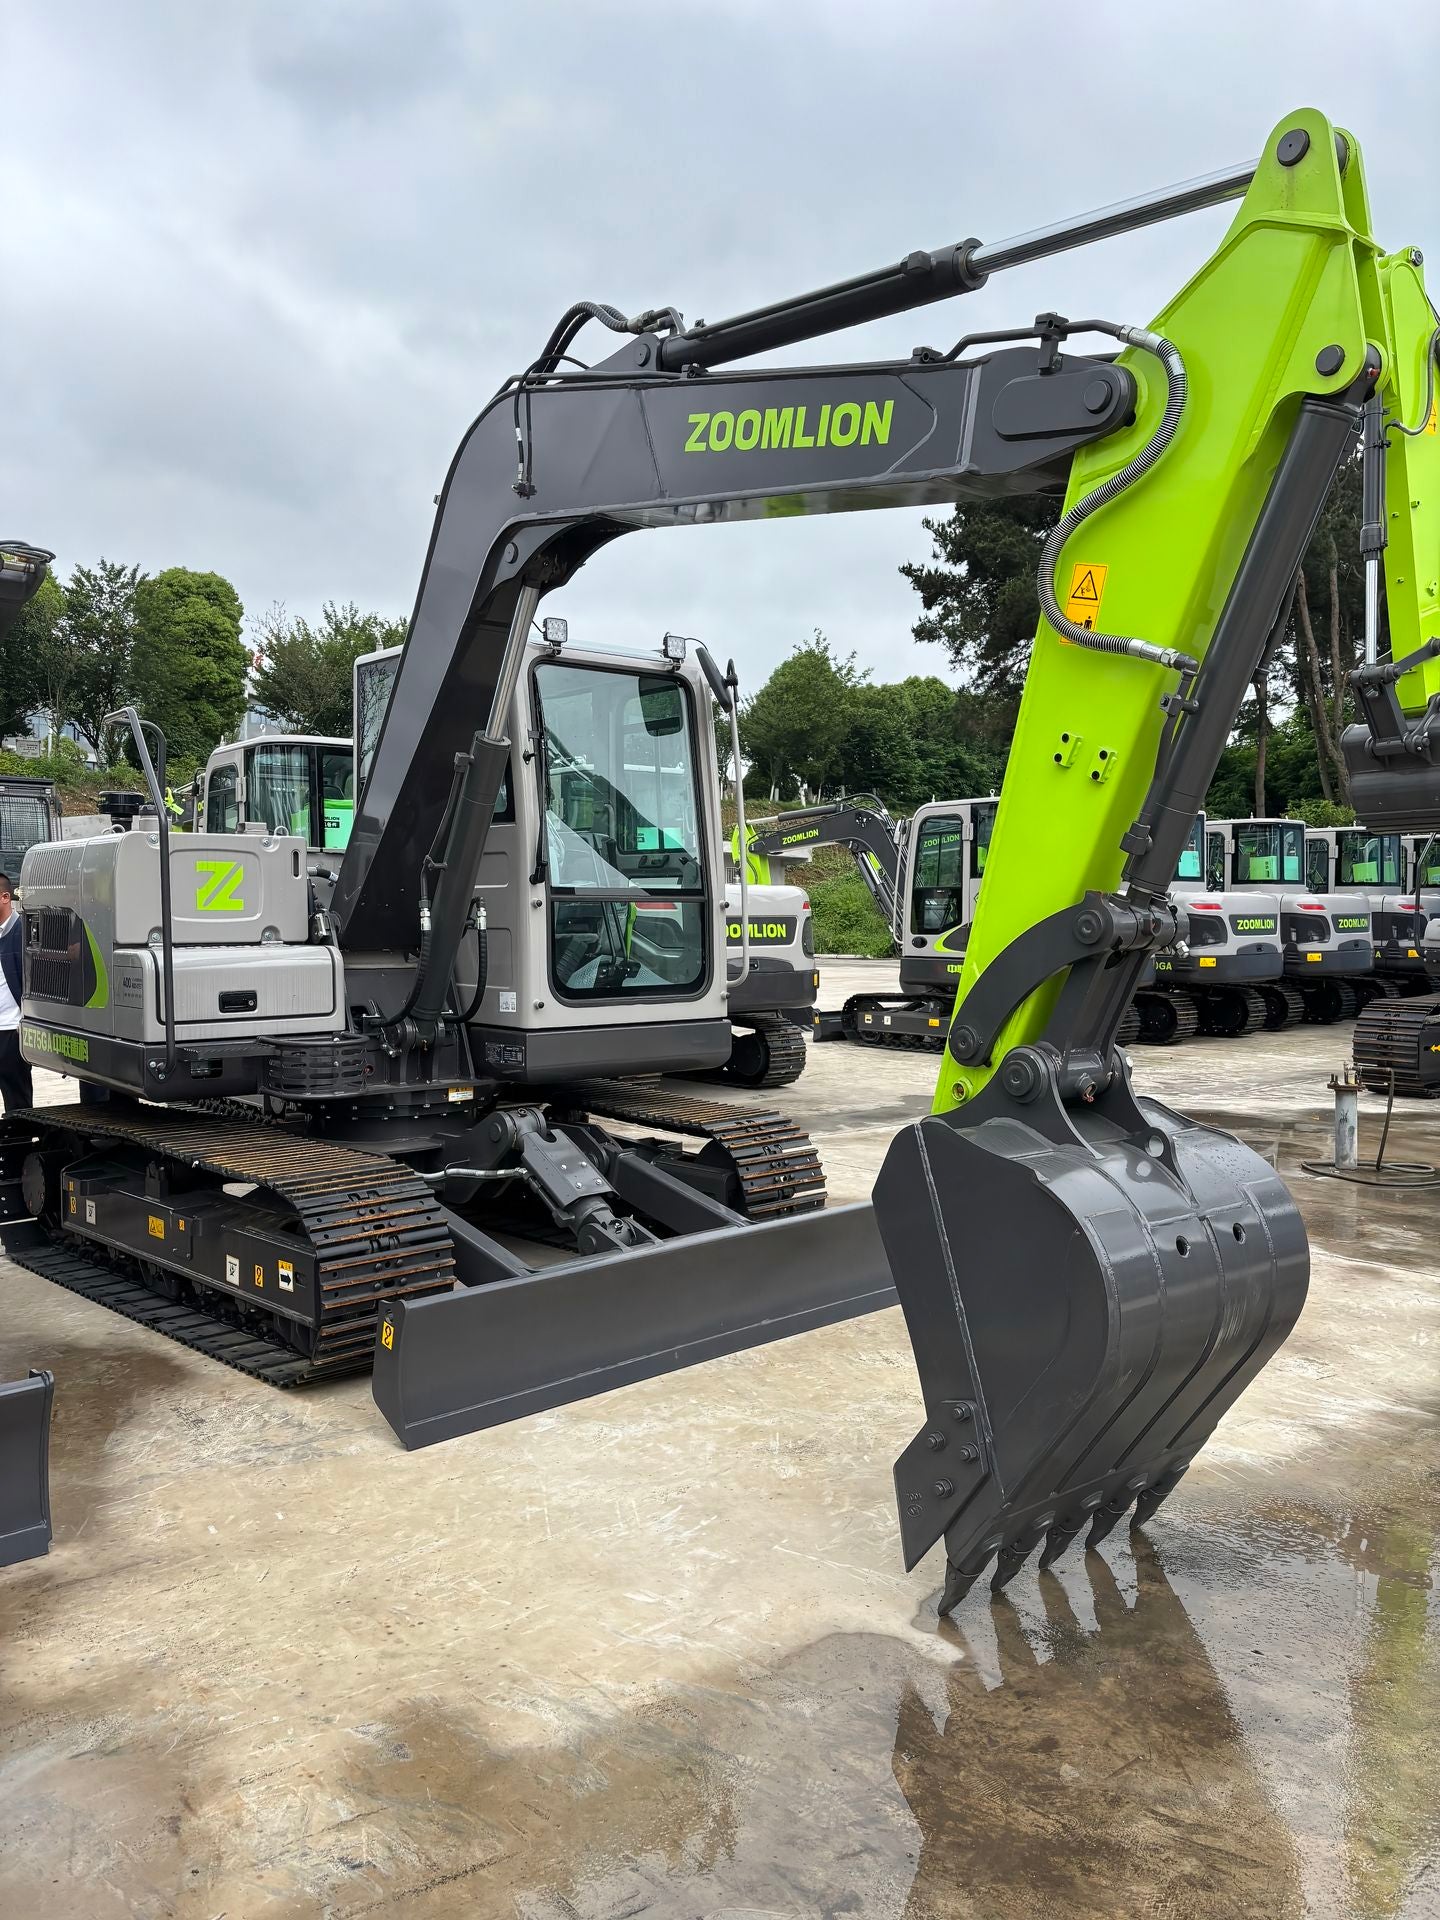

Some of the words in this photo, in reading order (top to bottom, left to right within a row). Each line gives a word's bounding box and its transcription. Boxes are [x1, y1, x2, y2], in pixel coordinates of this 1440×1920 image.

[684, 400, 895, 452] ZOOMLION
[782, 828, 819, 845] ZOOMLION
[1236, 919, 1275, 930] ZOOMLION
[22, 1026, 53, 1053] ZE75GA
